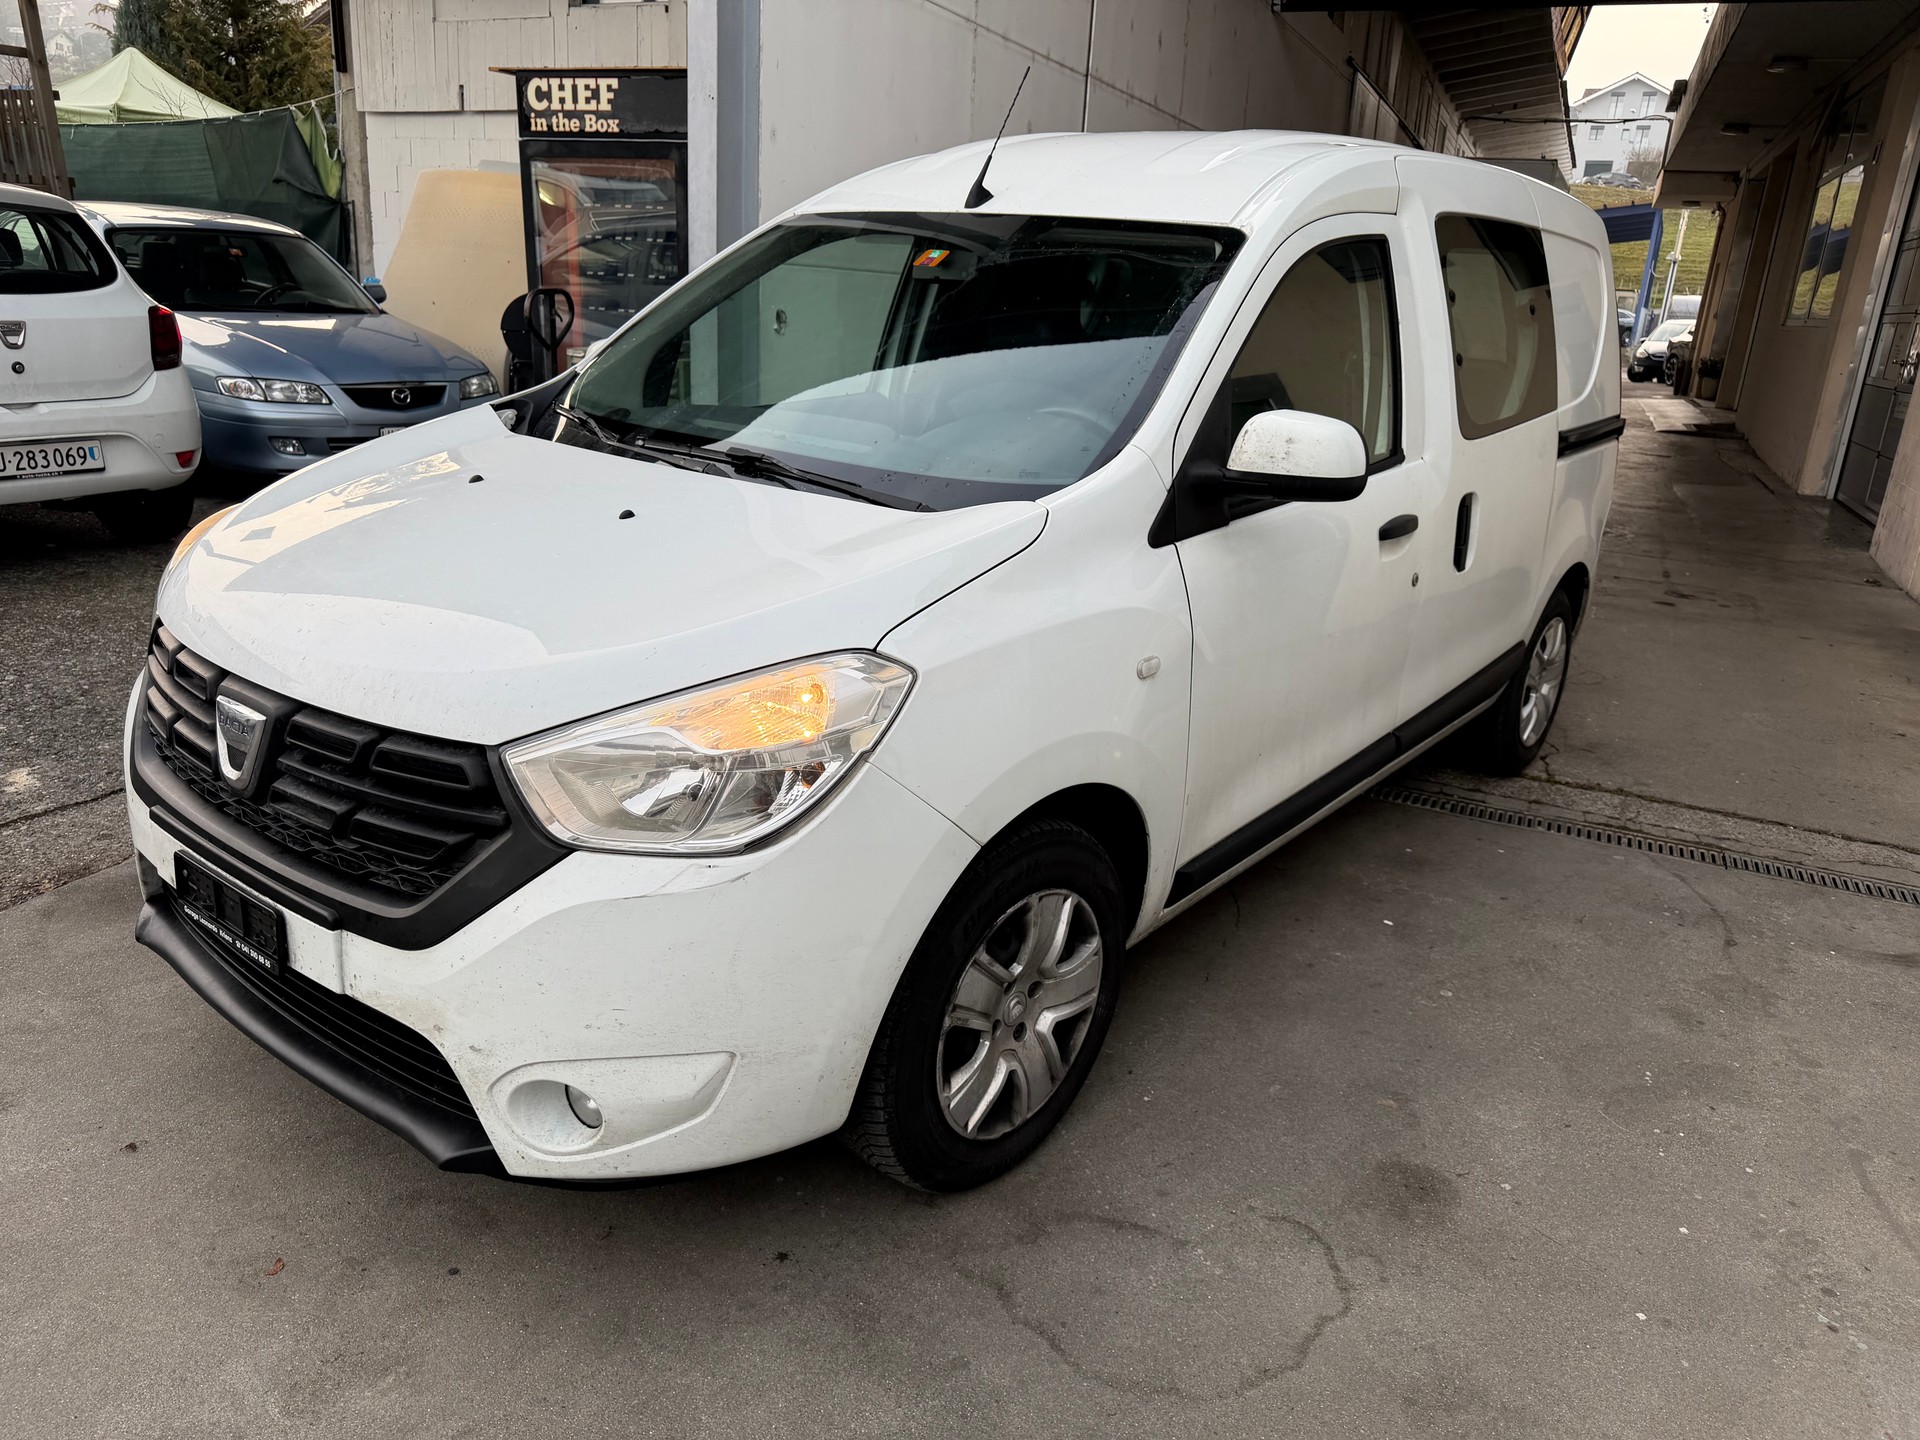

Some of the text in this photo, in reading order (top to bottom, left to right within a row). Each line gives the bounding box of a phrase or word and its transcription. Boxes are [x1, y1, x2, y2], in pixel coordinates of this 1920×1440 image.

[527, 77, 619, 112] CHEF
[530, 112, 620, 133] in the Box
[218, 711, 250, 739] DACIA
